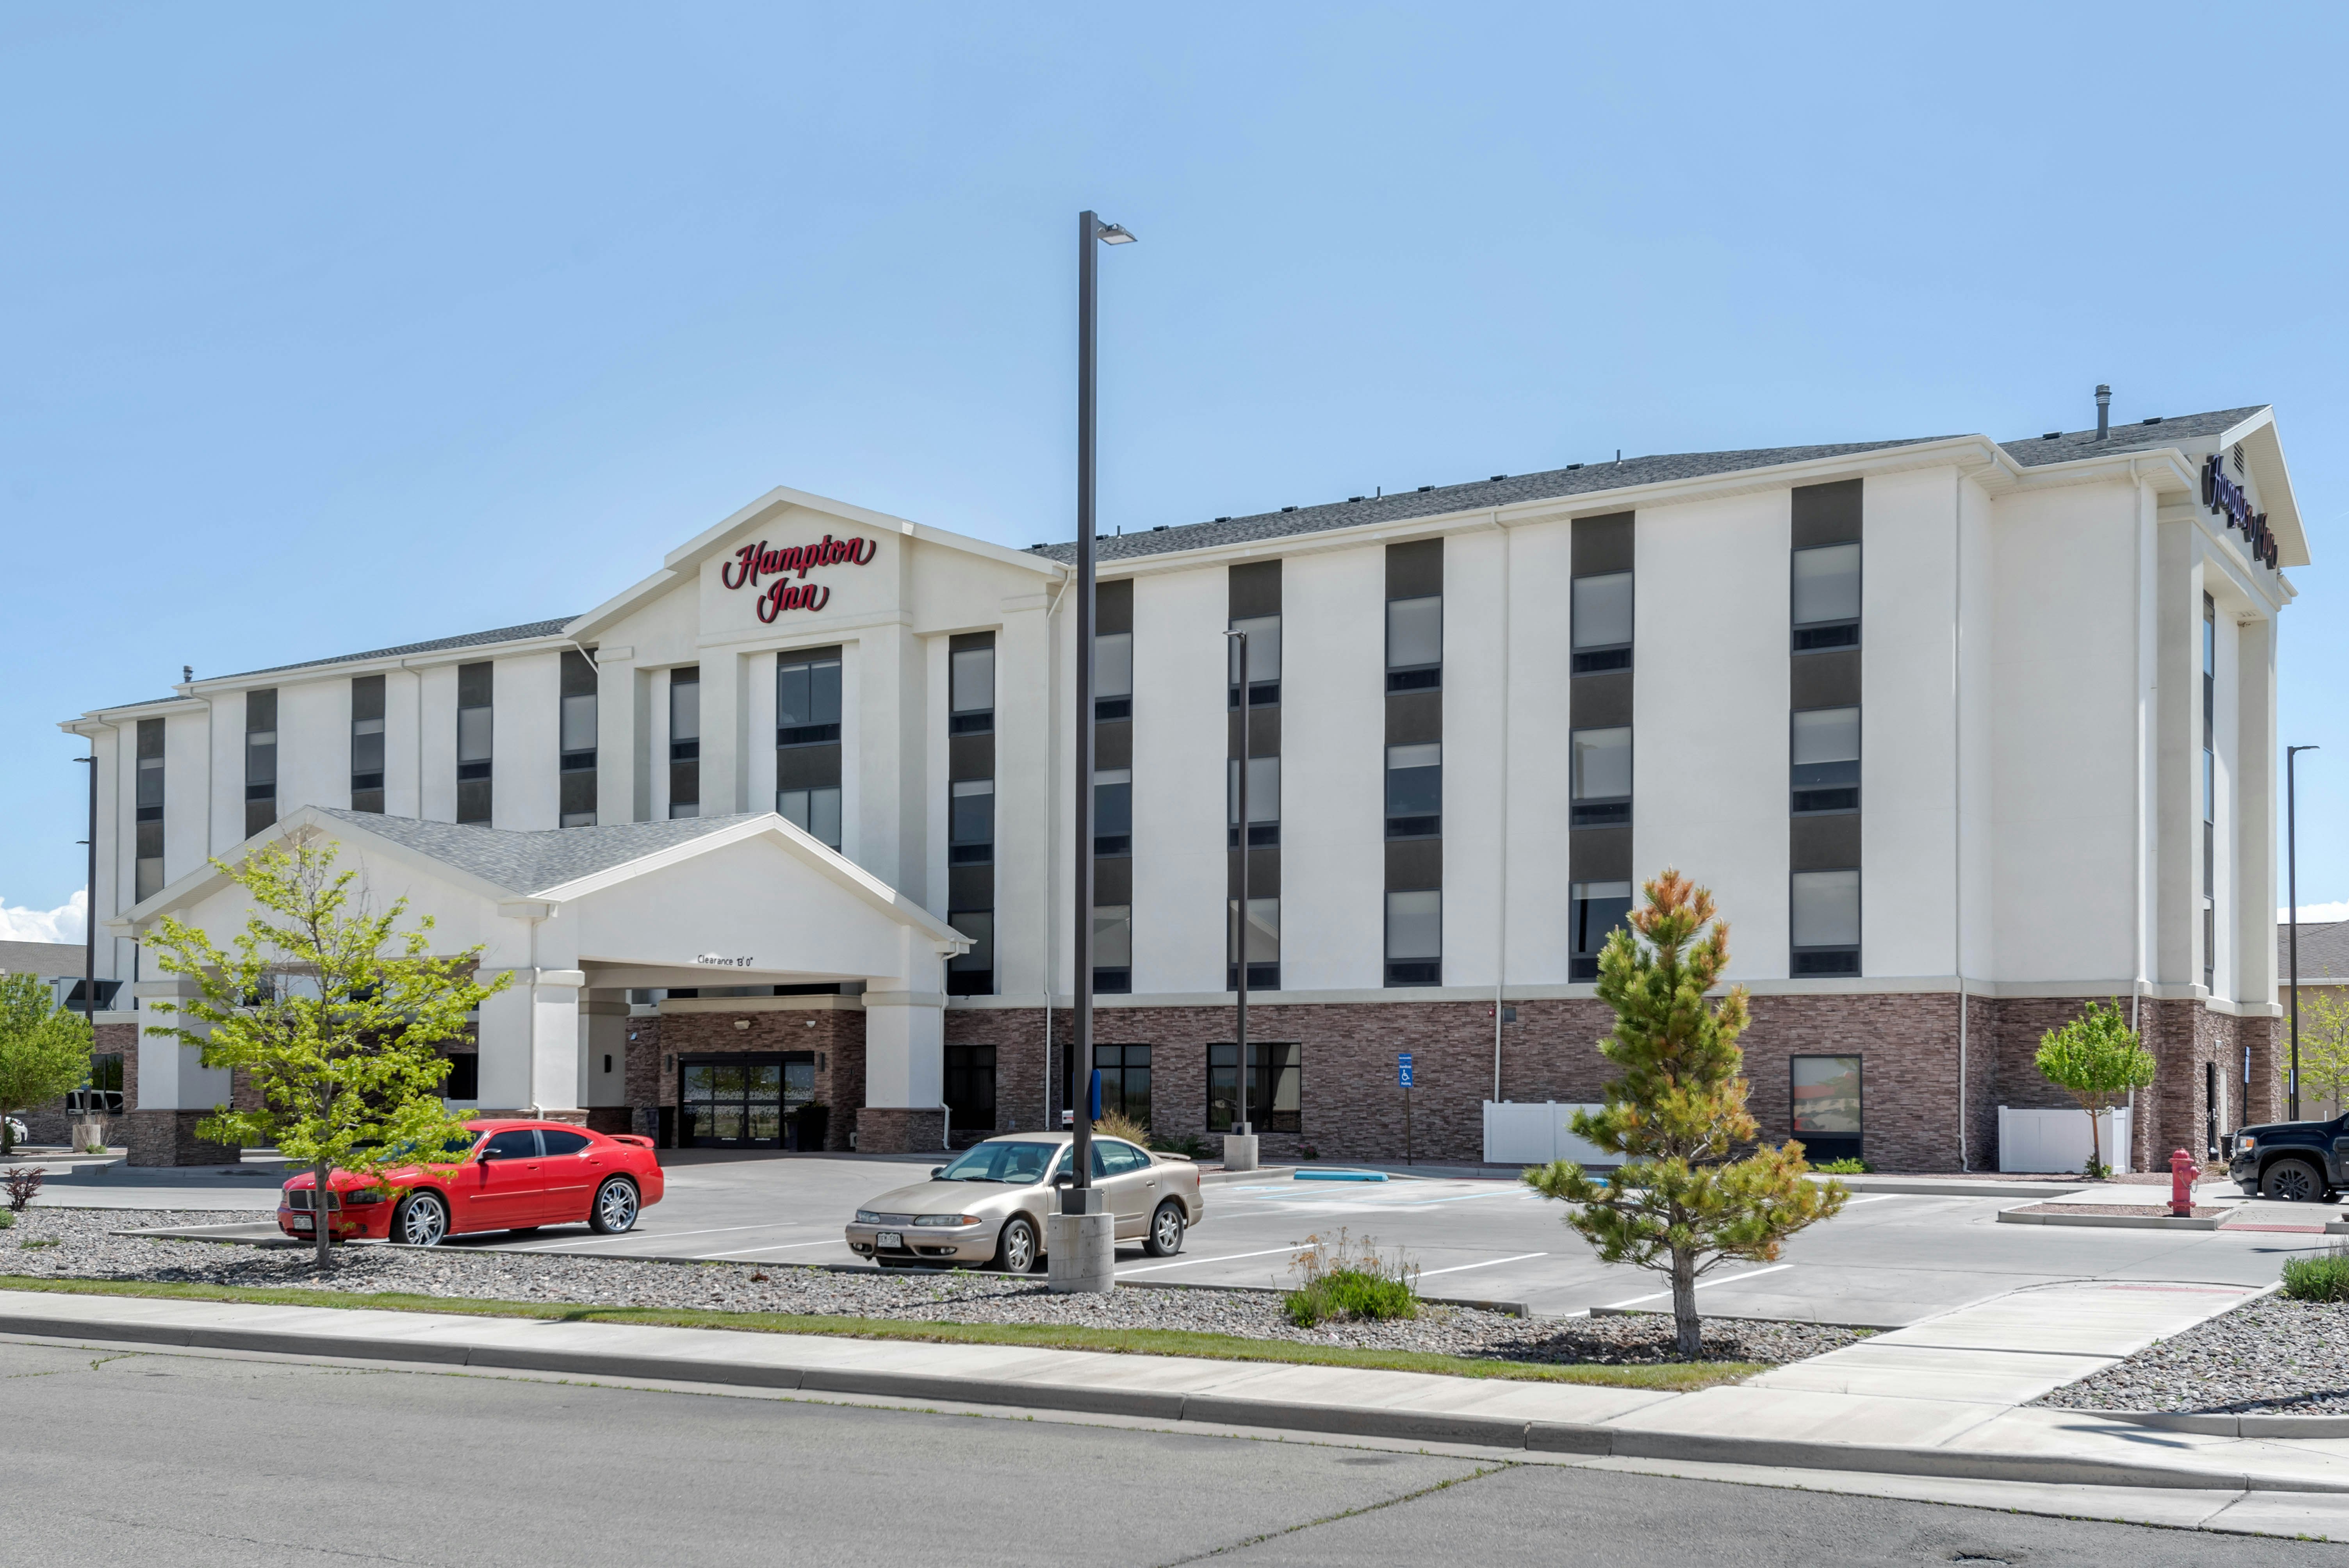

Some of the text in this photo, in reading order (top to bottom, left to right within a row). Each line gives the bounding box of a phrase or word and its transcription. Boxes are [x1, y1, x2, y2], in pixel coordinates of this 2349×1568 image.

[722, 535, 876, 589] Hampton
[757, 577, 829, 624] Inn
[698, 955, 733, 966] Clearance
